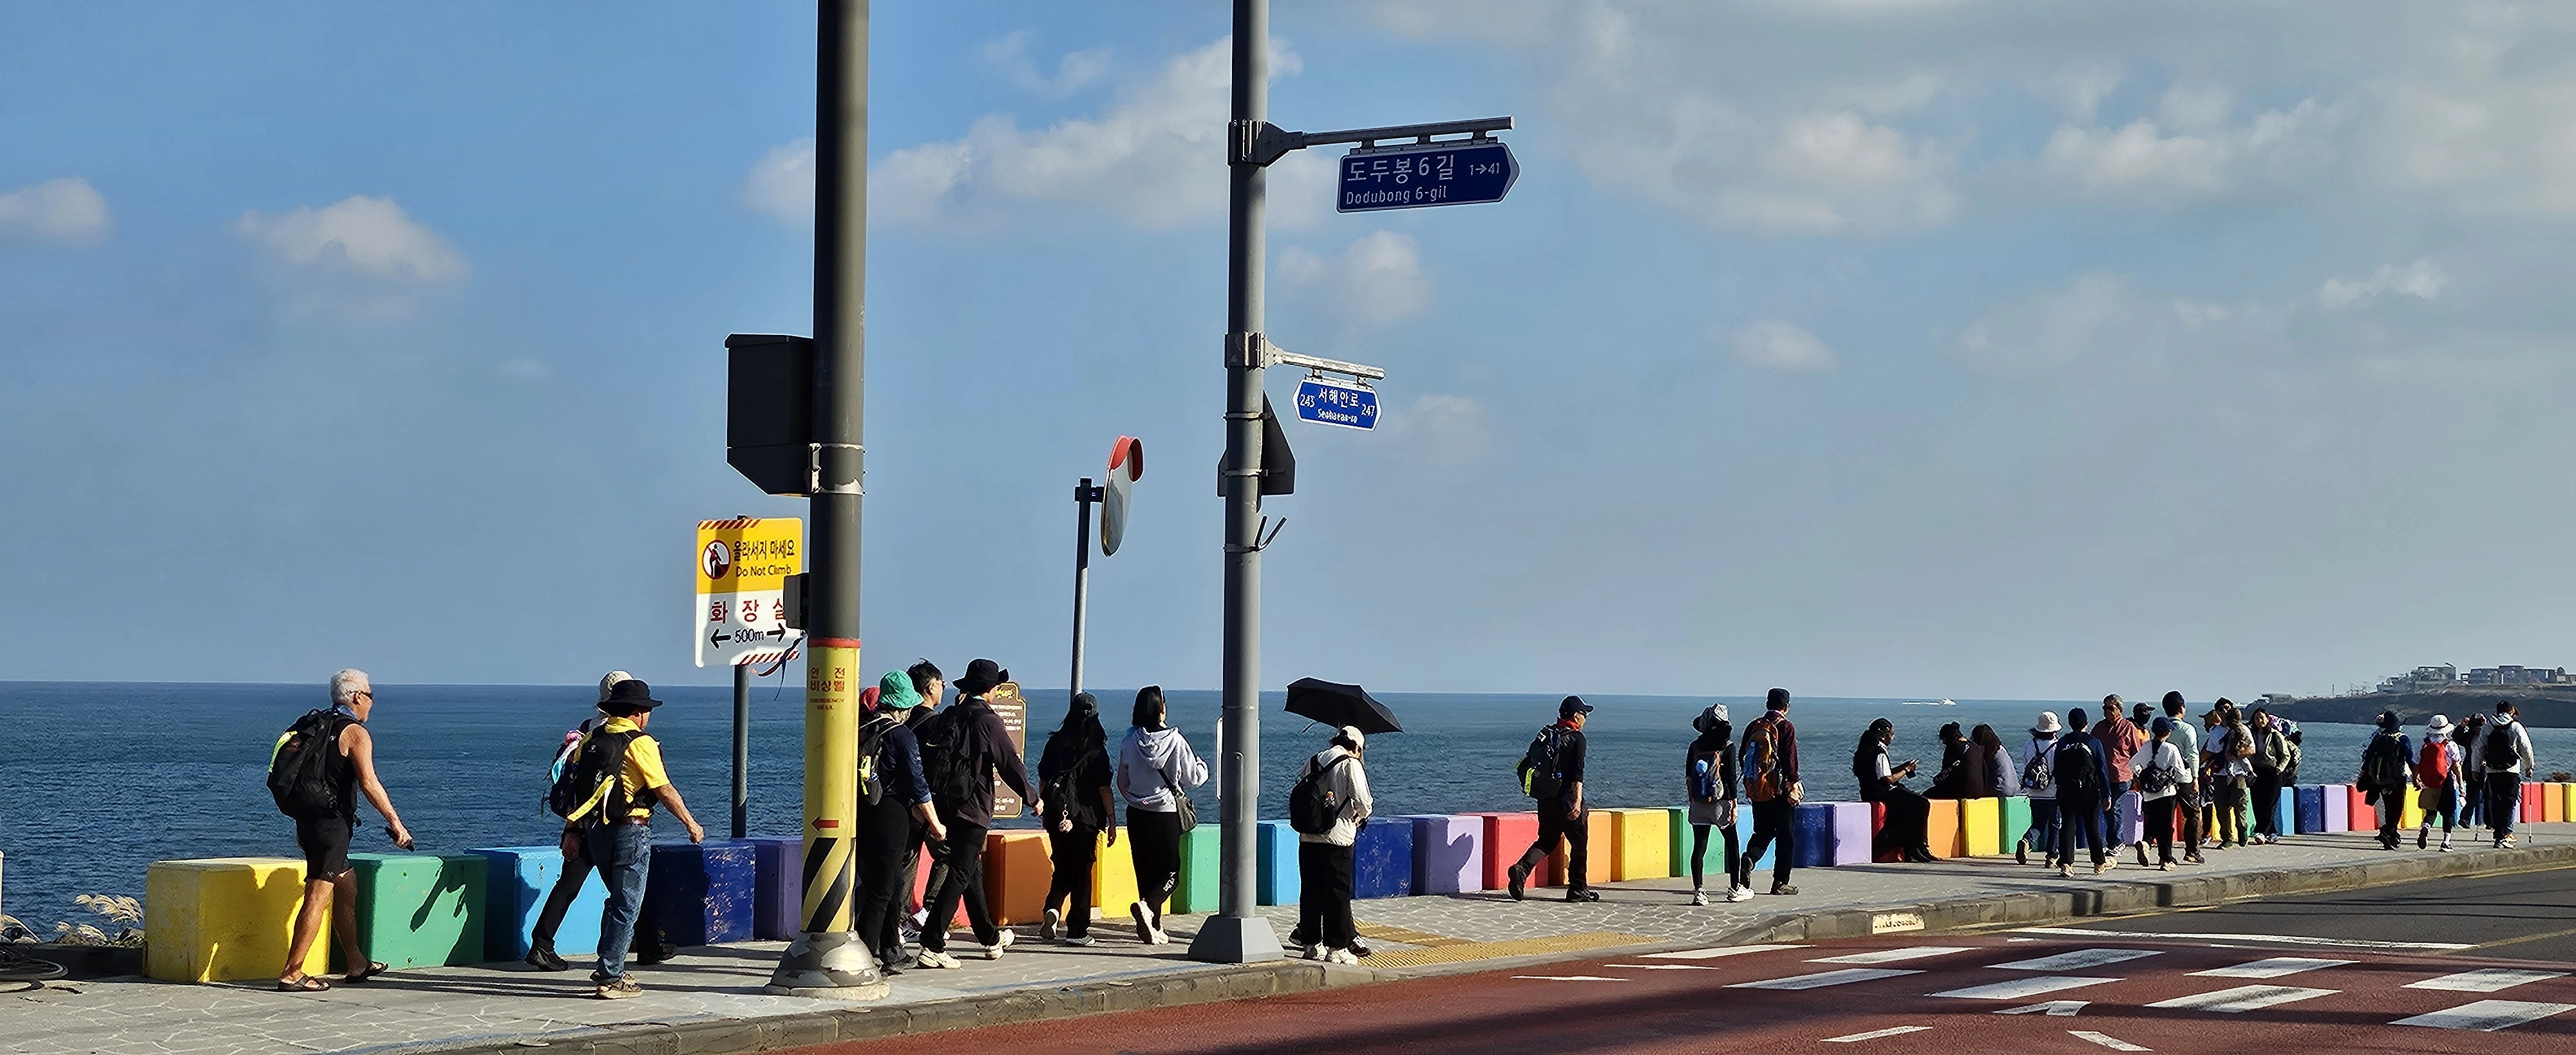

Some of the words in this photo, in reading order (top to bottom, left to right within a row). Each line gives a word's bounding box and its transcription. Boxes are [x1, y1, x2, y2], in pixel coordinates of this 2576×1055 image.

[1346, 190, 1410, 205] Dodubong
[1416, 185, 1446, 202] 6-gil
[1318, 388, 1358, 408] 서해안로
[1361, 404, 1376, 417] 247
[770, 539, 795, 559] 마세요
[736, 566, 748, 578] Do
[750, 566, 766, 576] Not
[734, 629, 764, 643] 500m
